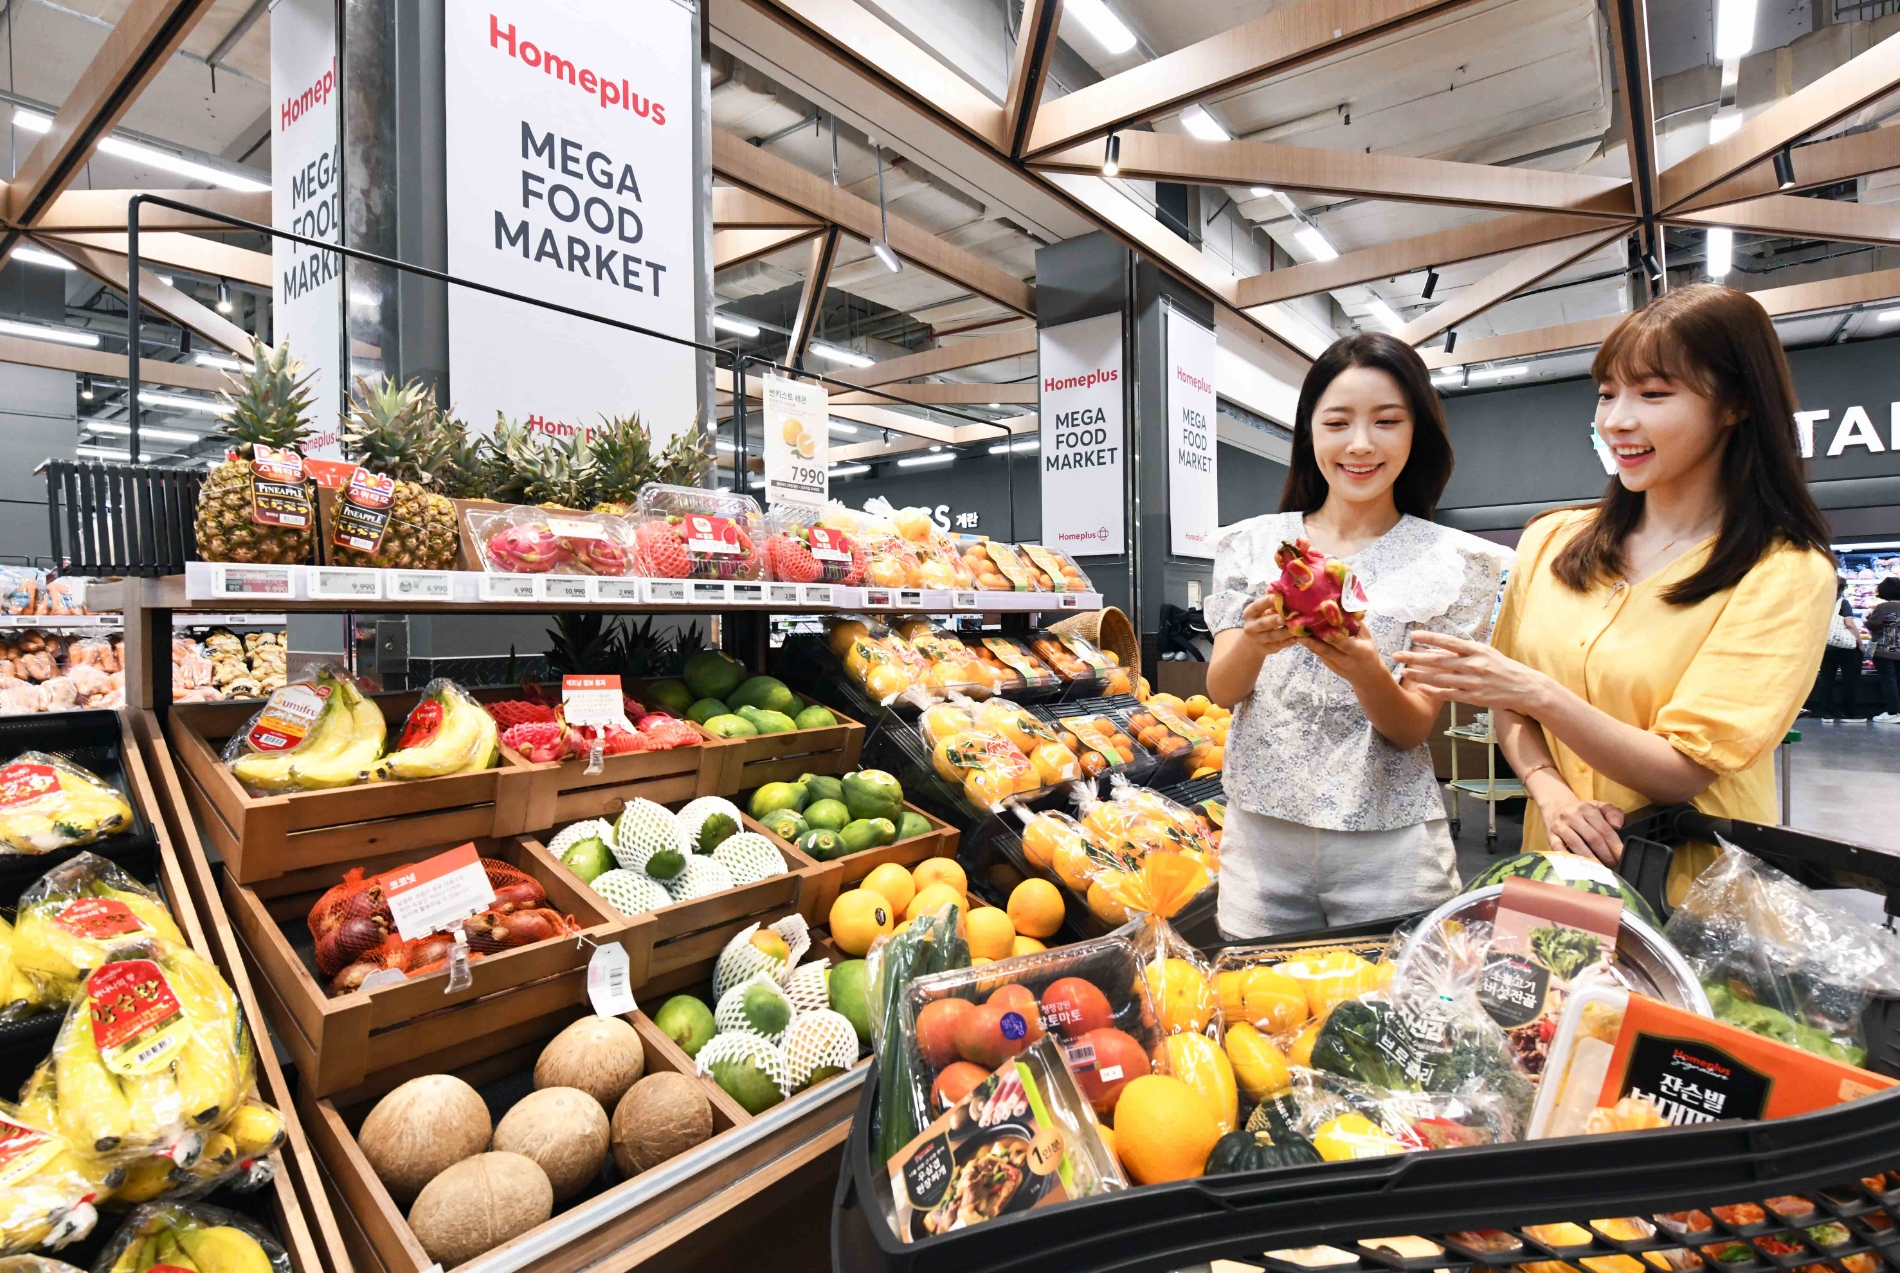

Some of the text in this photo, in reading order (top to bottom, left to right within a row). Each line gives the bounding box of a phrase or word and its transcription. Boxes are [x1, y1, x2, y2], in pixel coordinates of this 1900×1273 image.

[489, 14, 666, 126] Homeplus
[521, 121, 642, 202] MEGA
[521, 170, 644, 245] FOOD
[494, 210, 667, 298] MARKET
[1044, 368, 1118, 393] Homeplus
[1176, 365, 1212, 395] Homeplus
[1055, 407, 1106, 430] MEGA
[1182, 407, 1207, 431] MEGA
[1055, 427, 1107, 450] FOOD
[1183, 428, 1208, 451] FOOD
[256, 445, 300, 466] Dole
[1046, 447, 1118, 472] MARKET
[1178, 449, 1212, 474] MARKET
[258, 484, 305, 498] PINEAPPLE
[353, 469, 394, 492] Dole
[343, 505, 384, 525] PINEAPPLE
[955, 511, 979, 529] 계란
[1058, 530, 1097, 542] Homeplus
[273, 692, 318, 717] Sumifru
[389, 872, 418, 891] 코코넛
[1483, 977, 1538, 1009] 버섯전골
[1041, 1000, 1071, 1014] 청정강원
[1036, 1008, 1083, 1031] 찰토마토
[1670, 1053, 1730, 1081] Signature
[1673, 1048, 1732, 1076] Homeplus
